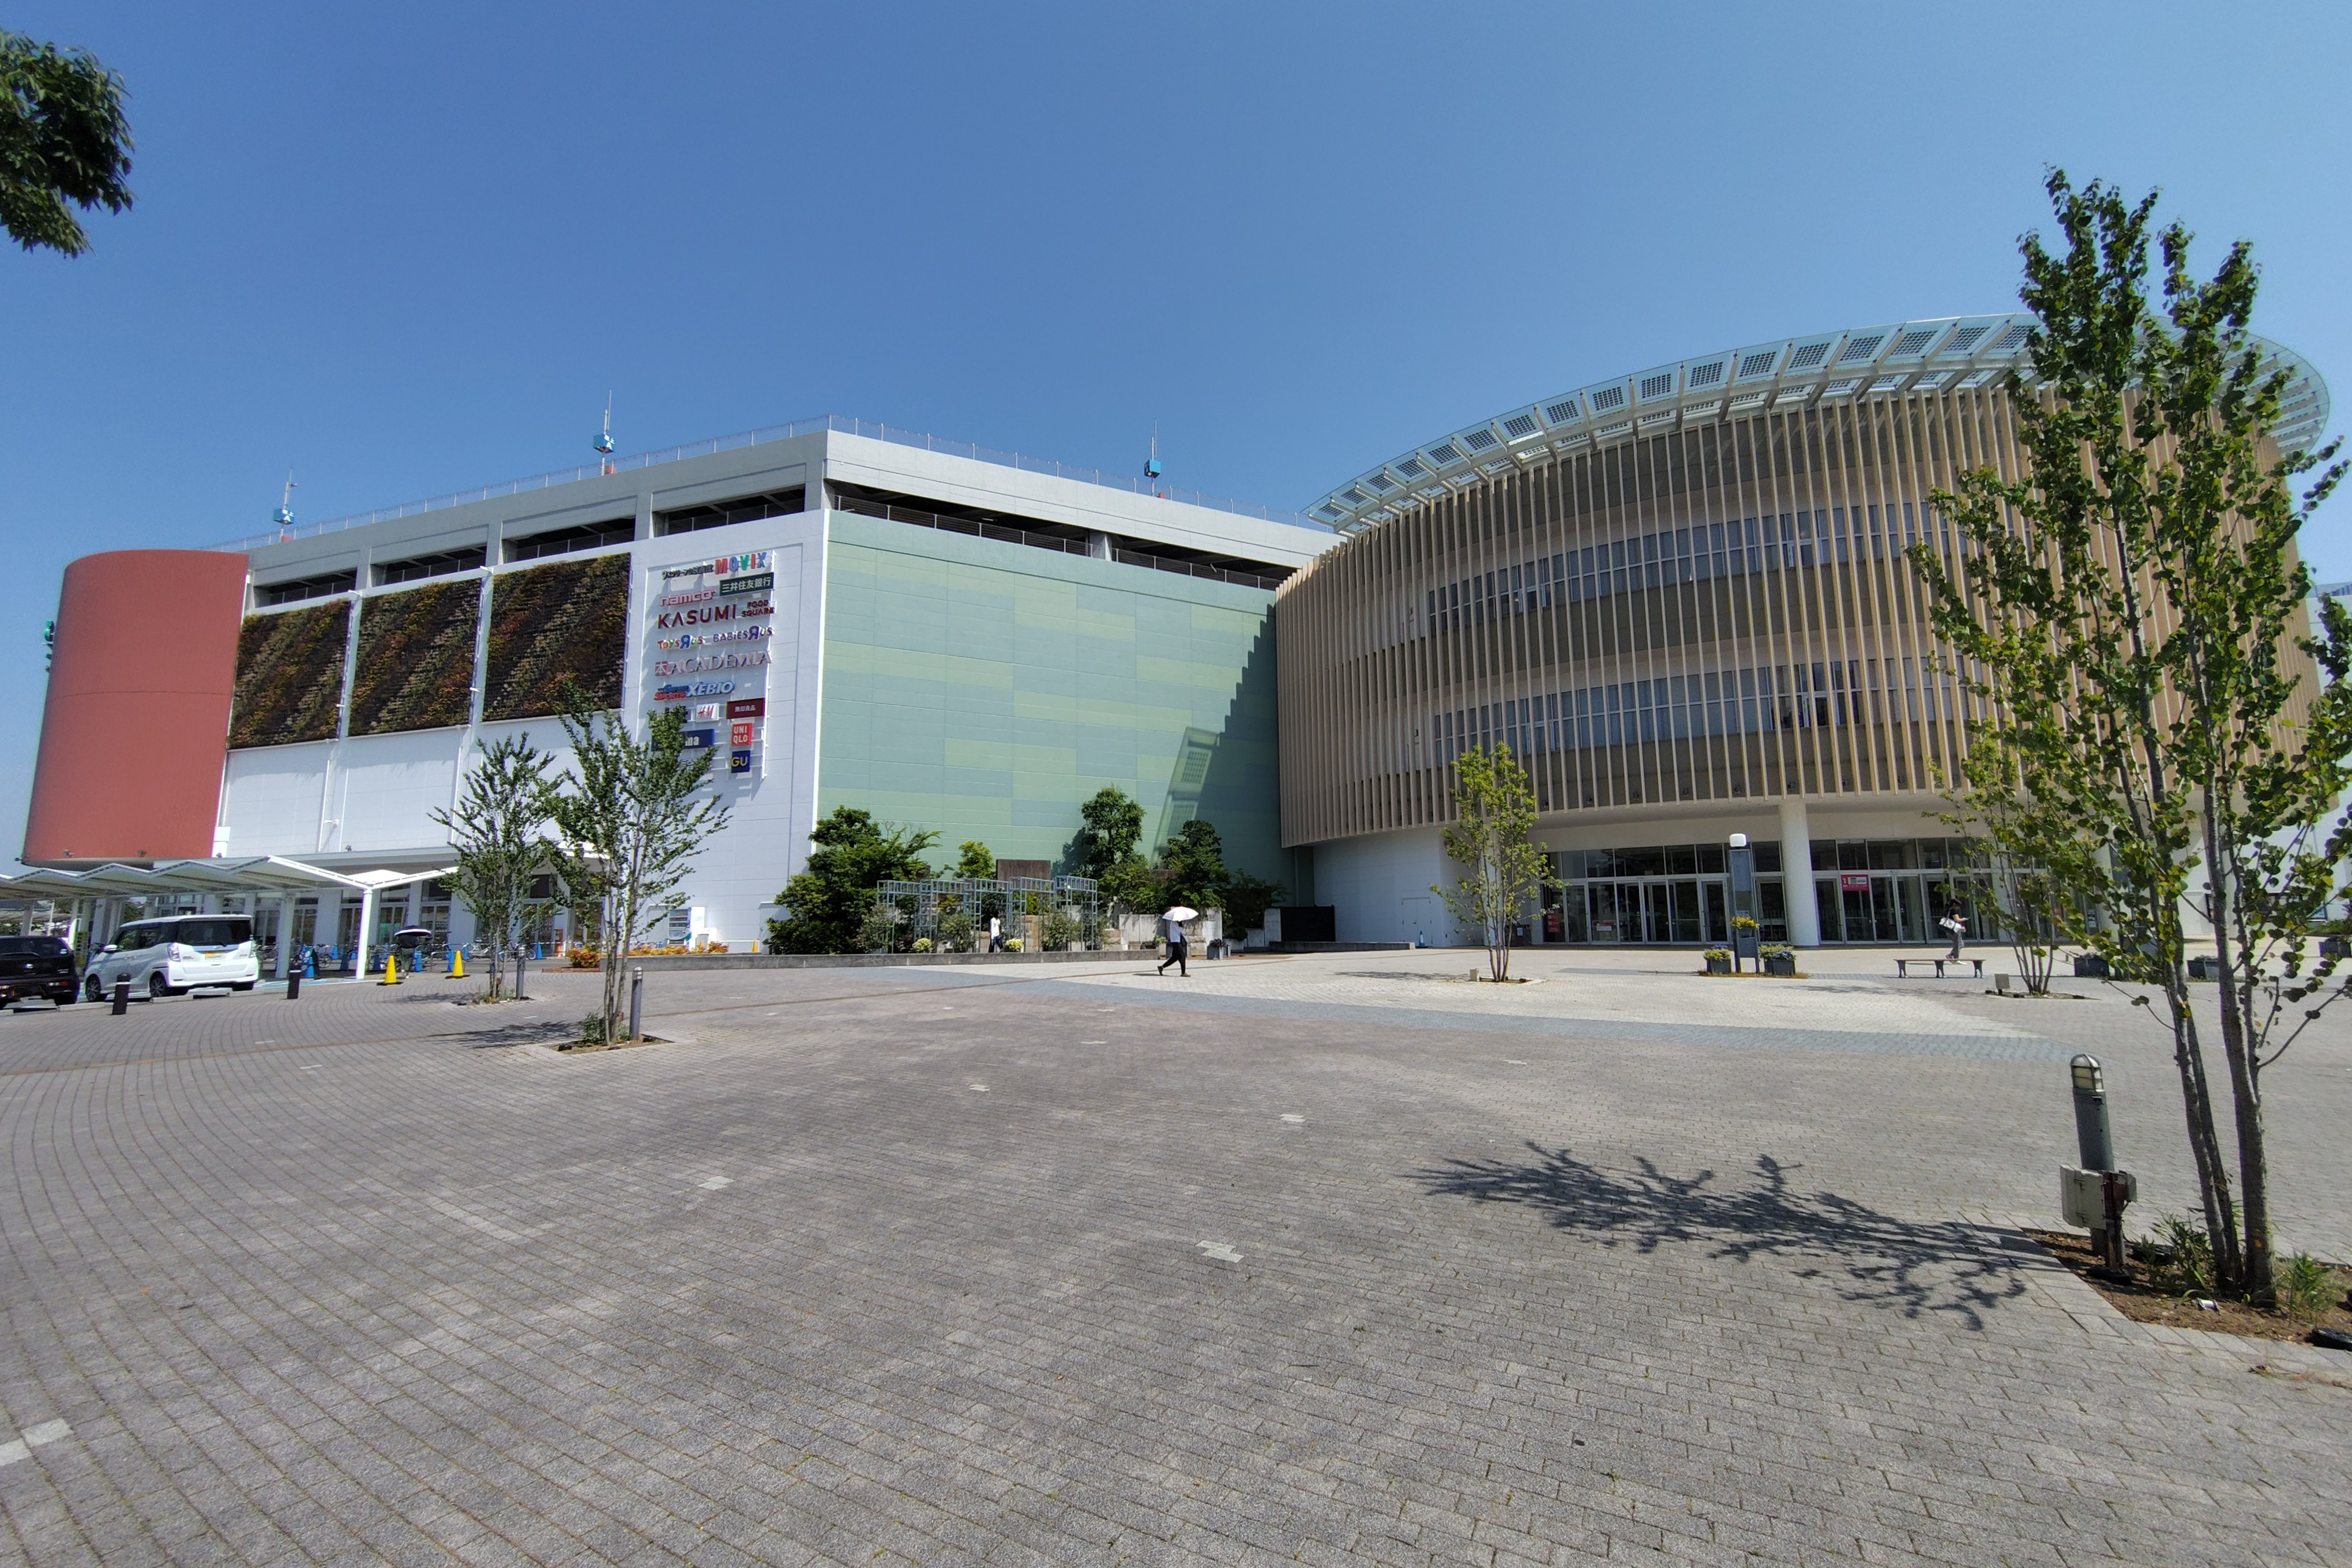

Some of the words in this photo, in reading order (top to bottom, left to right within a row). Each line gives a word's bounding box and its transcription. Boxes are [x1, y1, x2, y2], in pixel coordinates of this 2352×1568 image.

[715, 552, 767, 575] MOVIX
[722, 577, 772, 593] 三井住友銀行
[659, 589, 716, 607] namco
[747, 600, 769, 609] FOOD
[657, 604, 737, 629] KASUMI
[741, 607, 775, 618] SQUARE
[667, 650, 772, 675] ACADEMIA
[686, 681, 735, 697] XEBIO
[734, 725, 747, 734] UNI
[733, 735, 748, 744] QLO
[731, 756, 747, 767] GU
